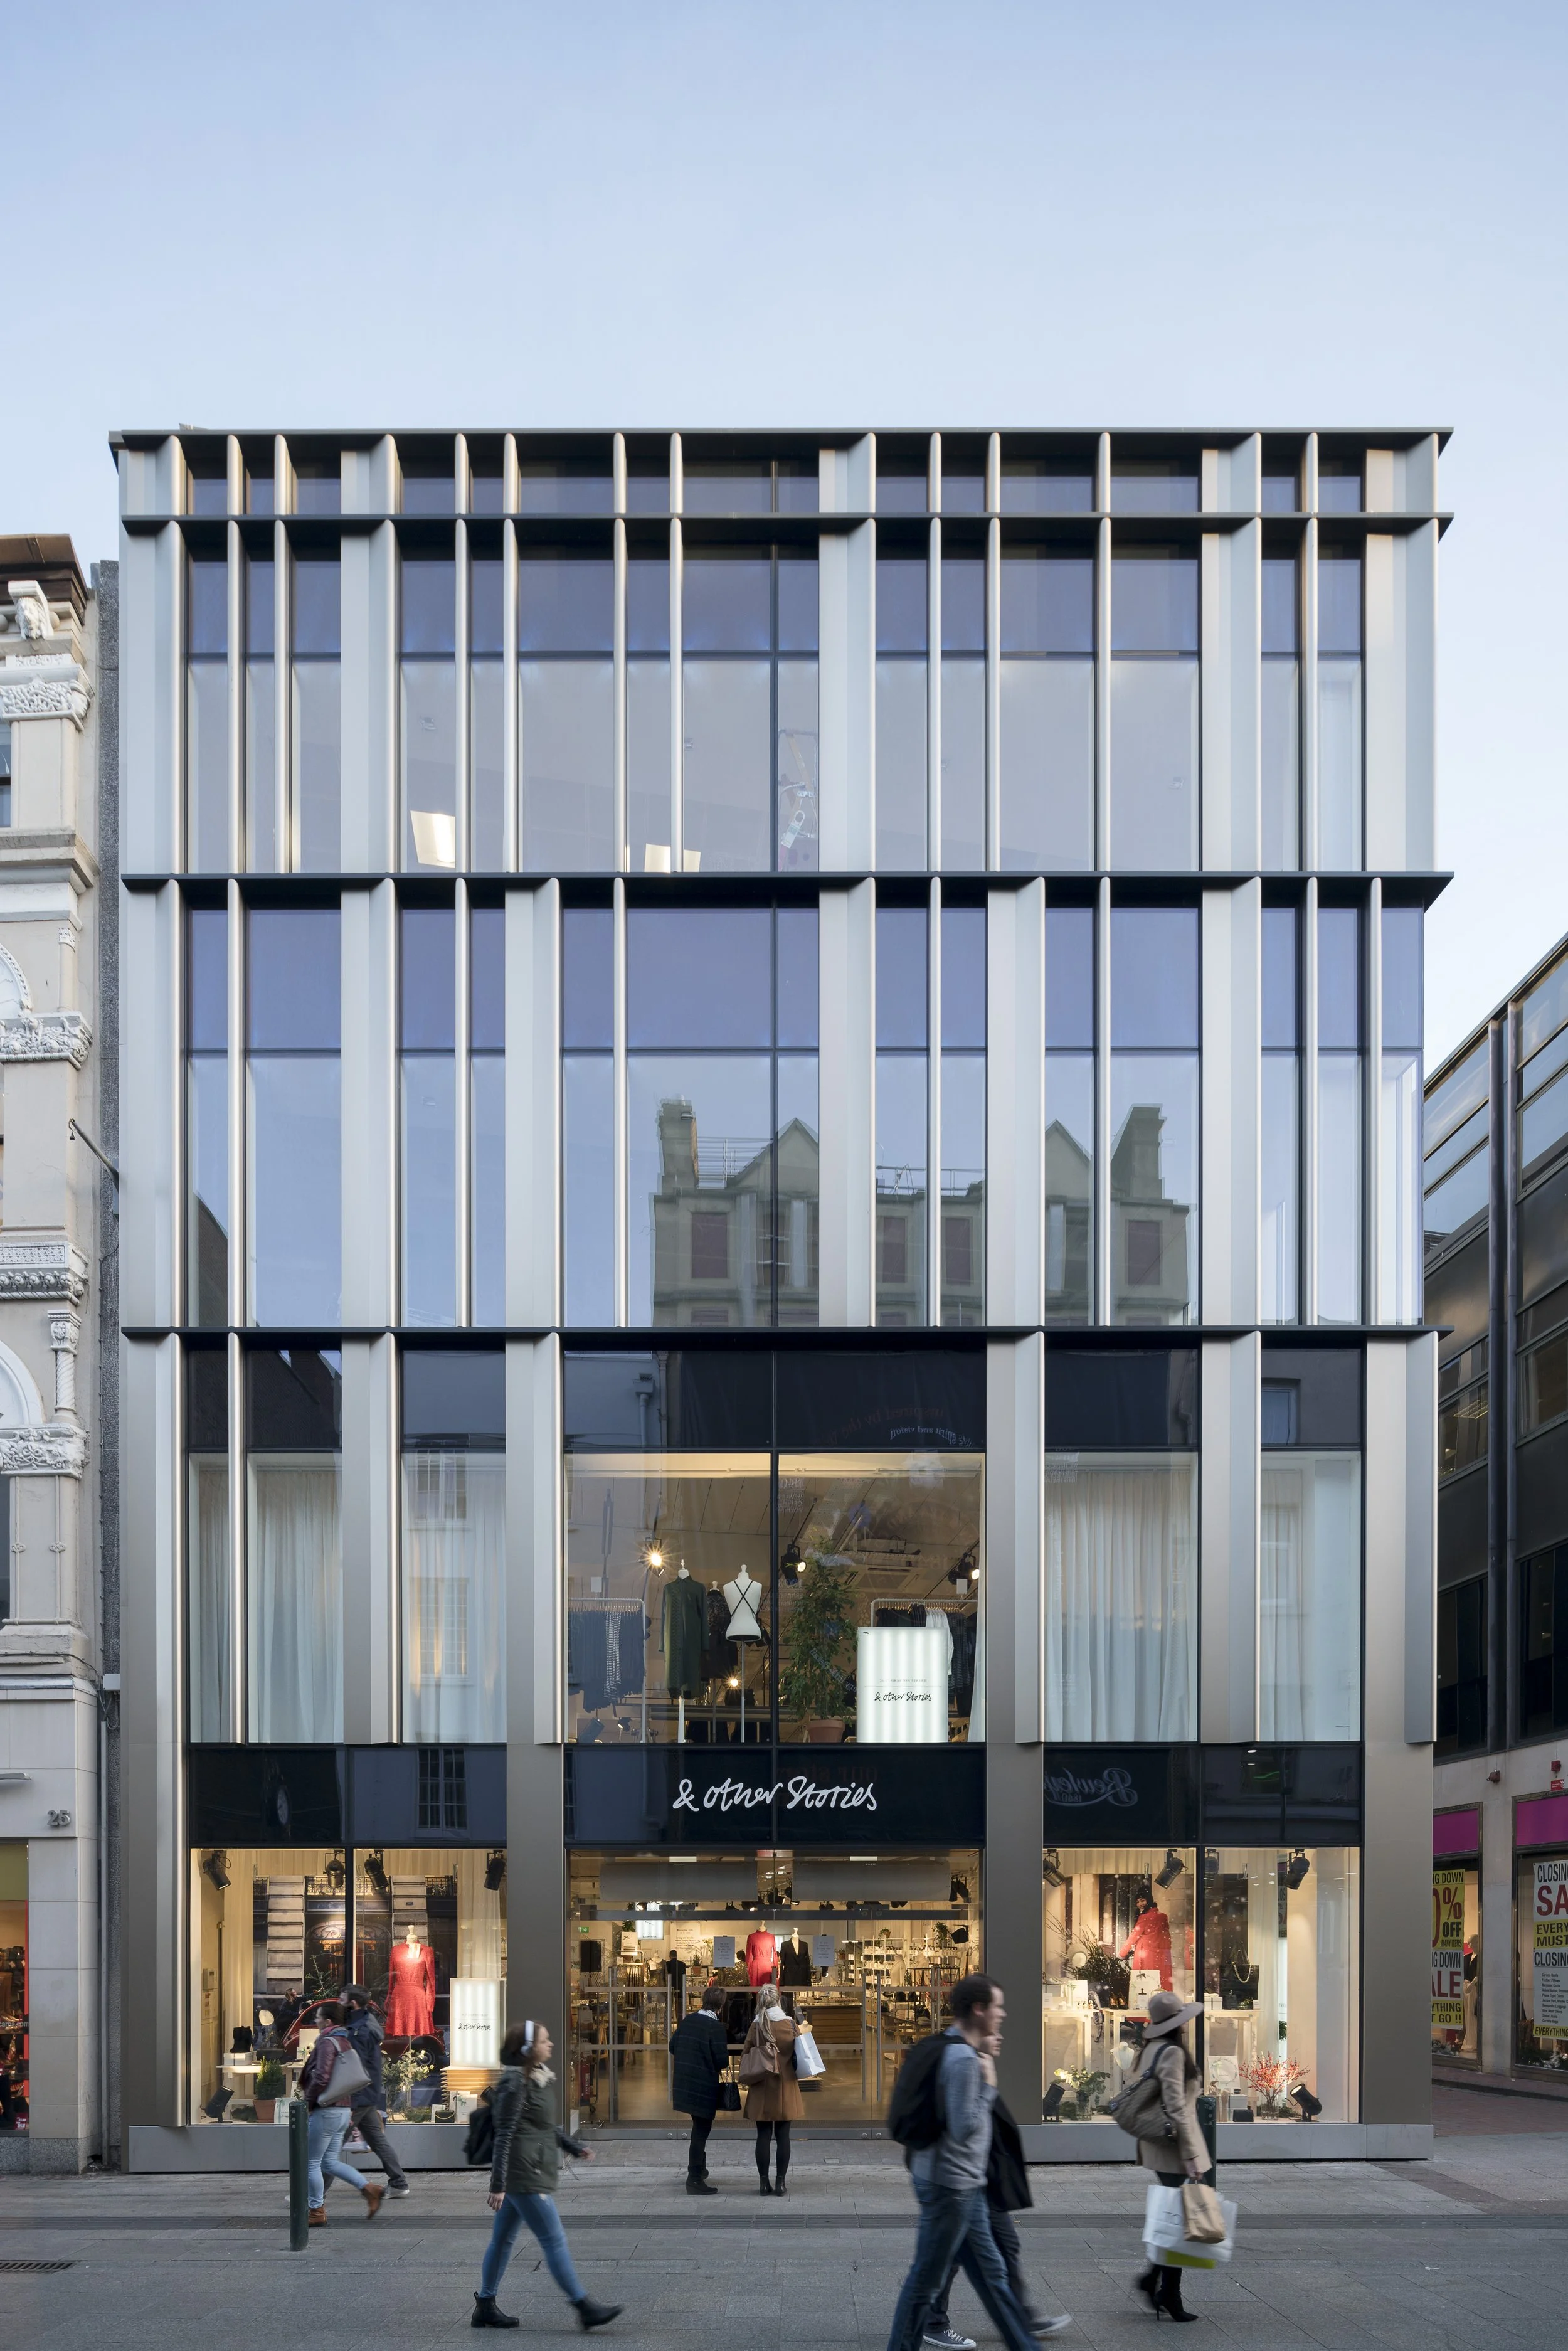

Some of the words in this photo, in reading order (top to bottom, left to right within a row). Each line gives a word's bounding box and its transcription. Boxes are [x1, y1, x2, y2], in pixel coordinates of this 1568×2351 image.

[874, 1692, 882, 1702] &
[883, 1692, 906, 1702] other
[906, 1691, 932, 1702] Stories
[673, 1779, 699, 1811] &
[703, 1778, 783, 1811] other
[787, 1776, 877, 1811] Stories
[47, 1810, 70, 1826] 25
[1442, 1871, 1463, 1884] DOWN
[1537, 1862, 1568, 1883] CLOSIN
[1443, 1922, 1462, 1938] OFF
[1441, 1940, 1451, 1948] MANY
[1451, 1939, 1462, 1948] ITEMS
[1537, 1934, 1568, 1947] MUST
[1439, 1952, 1461, 1968] DOWN
[1534, 1952, 1568, 1966] CLOSIN
[1439, 2014, 1451, 2023] GO
[1455, 2014, 1461, 2023] !!
